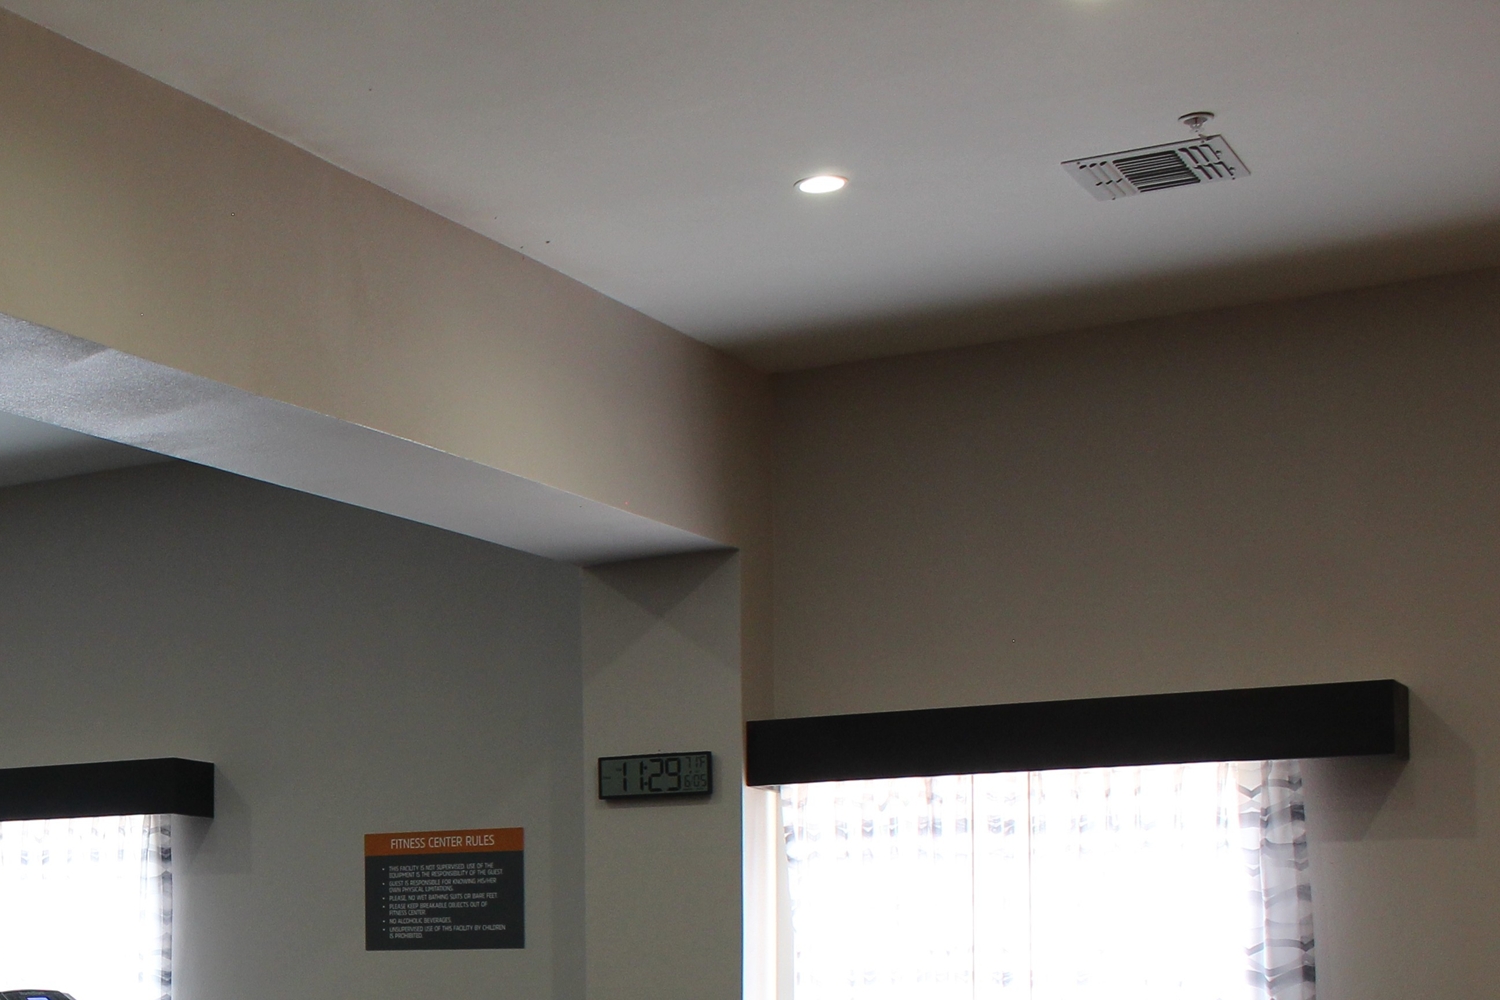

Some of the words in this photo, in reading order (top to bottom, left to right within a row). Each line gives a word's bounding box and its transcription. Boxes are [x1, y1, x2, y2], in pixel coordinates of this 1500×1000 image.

[622, 758, 680, 792] 11:29
[390, 837, 426, 849] FITNESS
[428, 836, 463, 847] CENTER
[465, 834, 495, 846] RULES
